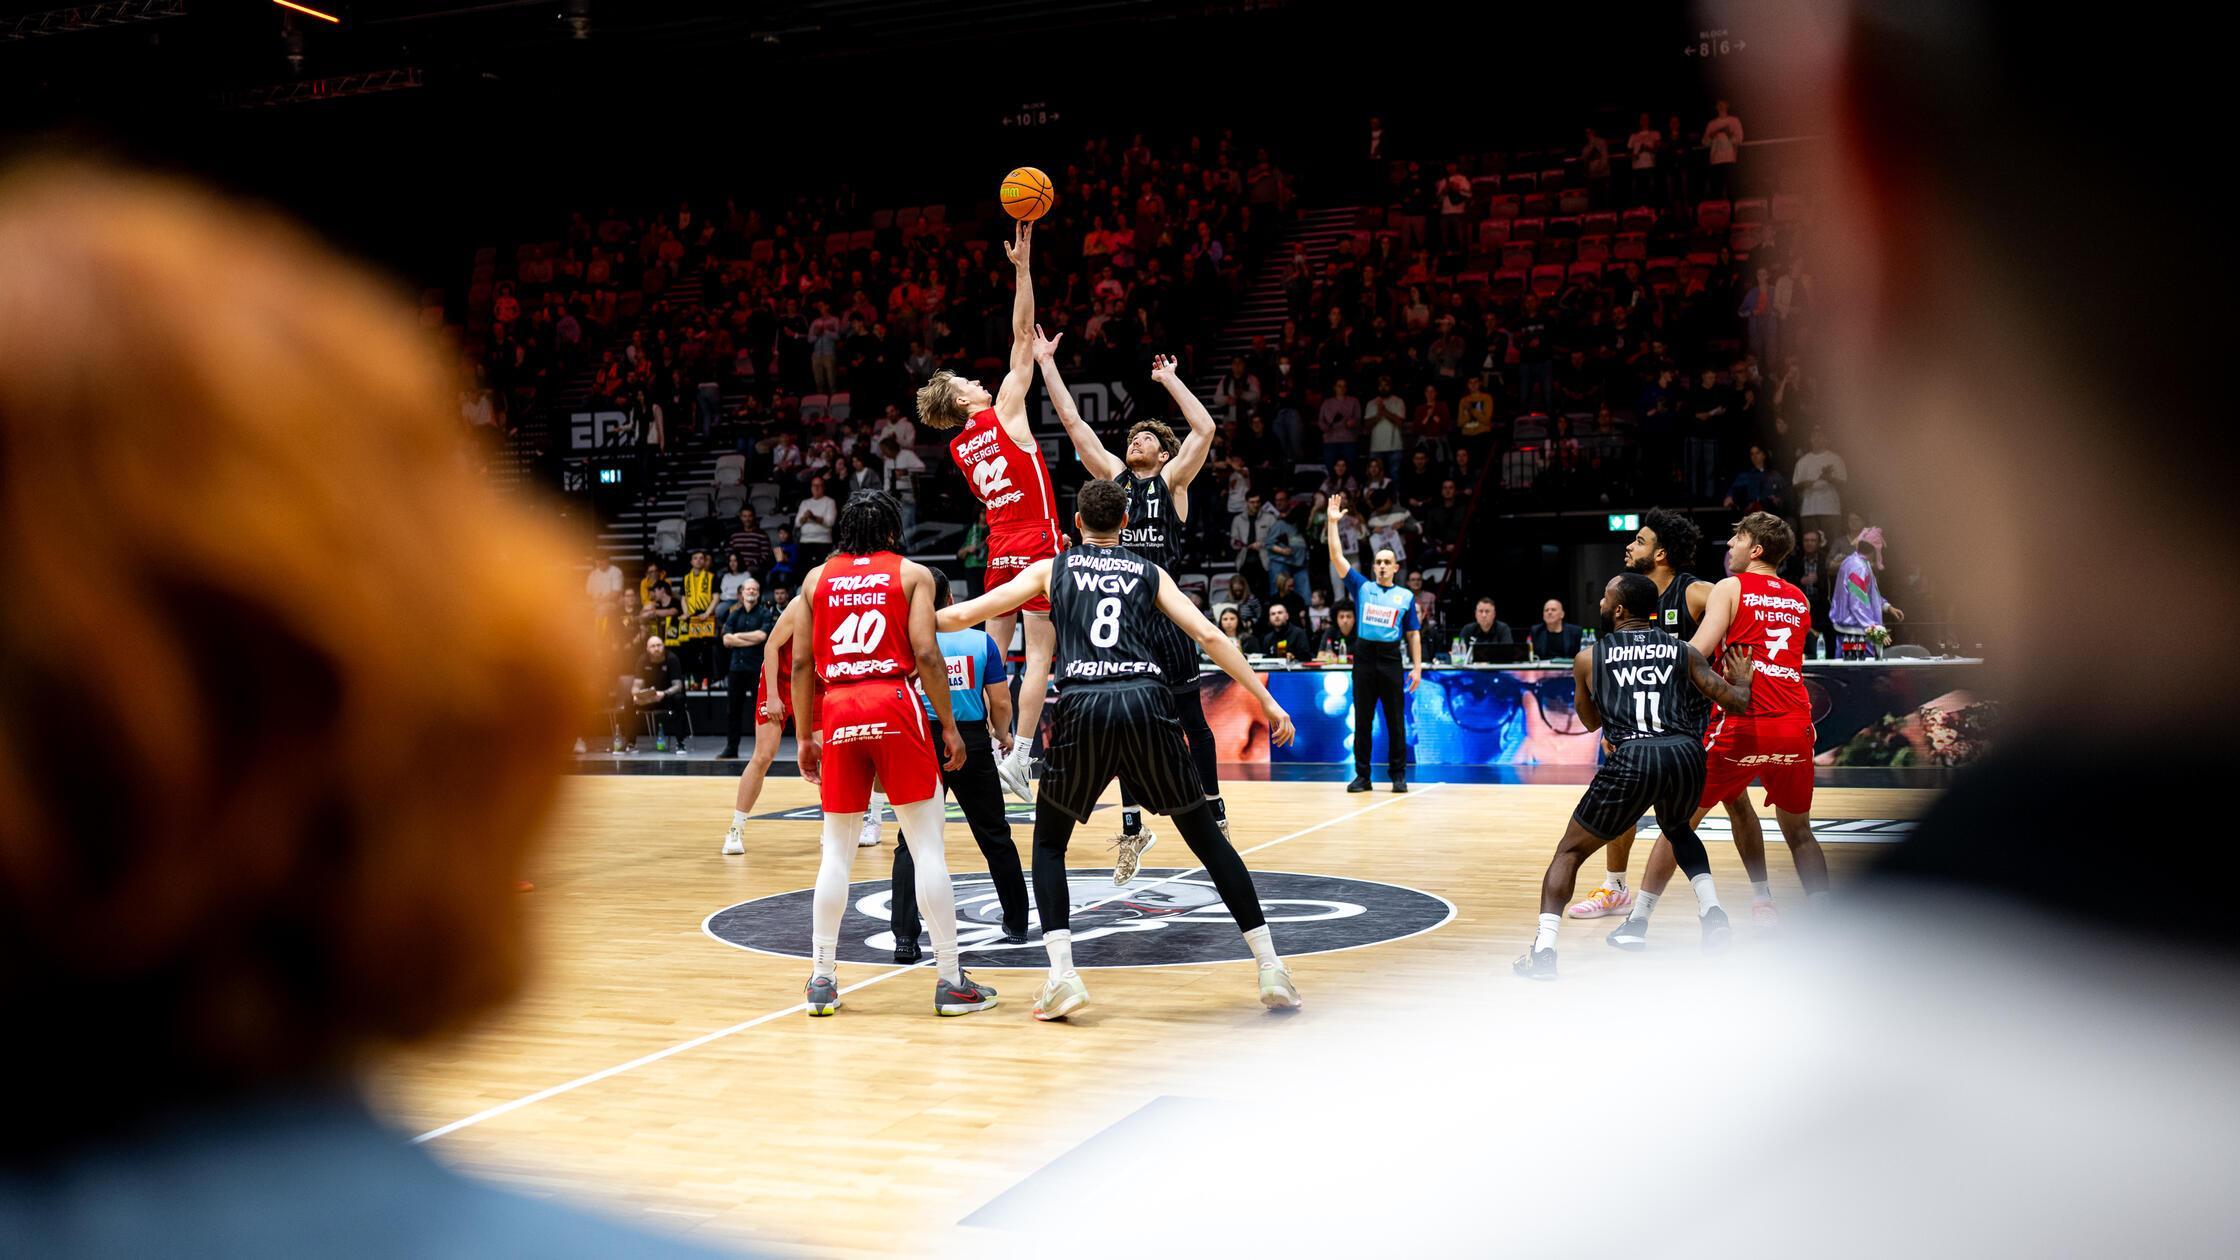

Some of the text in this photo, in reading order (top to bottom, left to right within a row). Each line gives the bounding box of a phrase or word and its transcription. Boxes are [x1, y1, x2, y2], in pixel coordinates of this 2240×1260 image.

[1700, 40, 1730, 57] 8 6
[1016, 111, 1047, 126] 10 8
[956, 427, 998, 458] BASKIN
[972, 455, 1012, 498] 22
[1146, 498, 1160, 519] 17
[1068, 554, 1144, 576] EDWARDSSON
[827, 573, 891, 592] TAYLOR
[1073, 571, 1139, 595] WGV
[830, 608, 887, 656] 10
[1090, 597, 1122, 649] 8
[1605, 643, 1678, 664] JOHNSON
[1764, 627, 1793, 661] 7
[1612, 664, 1674, 688] WGV
[1633, 691, 1665, 733] 11
[832, 722, 888, 741] ARZT
